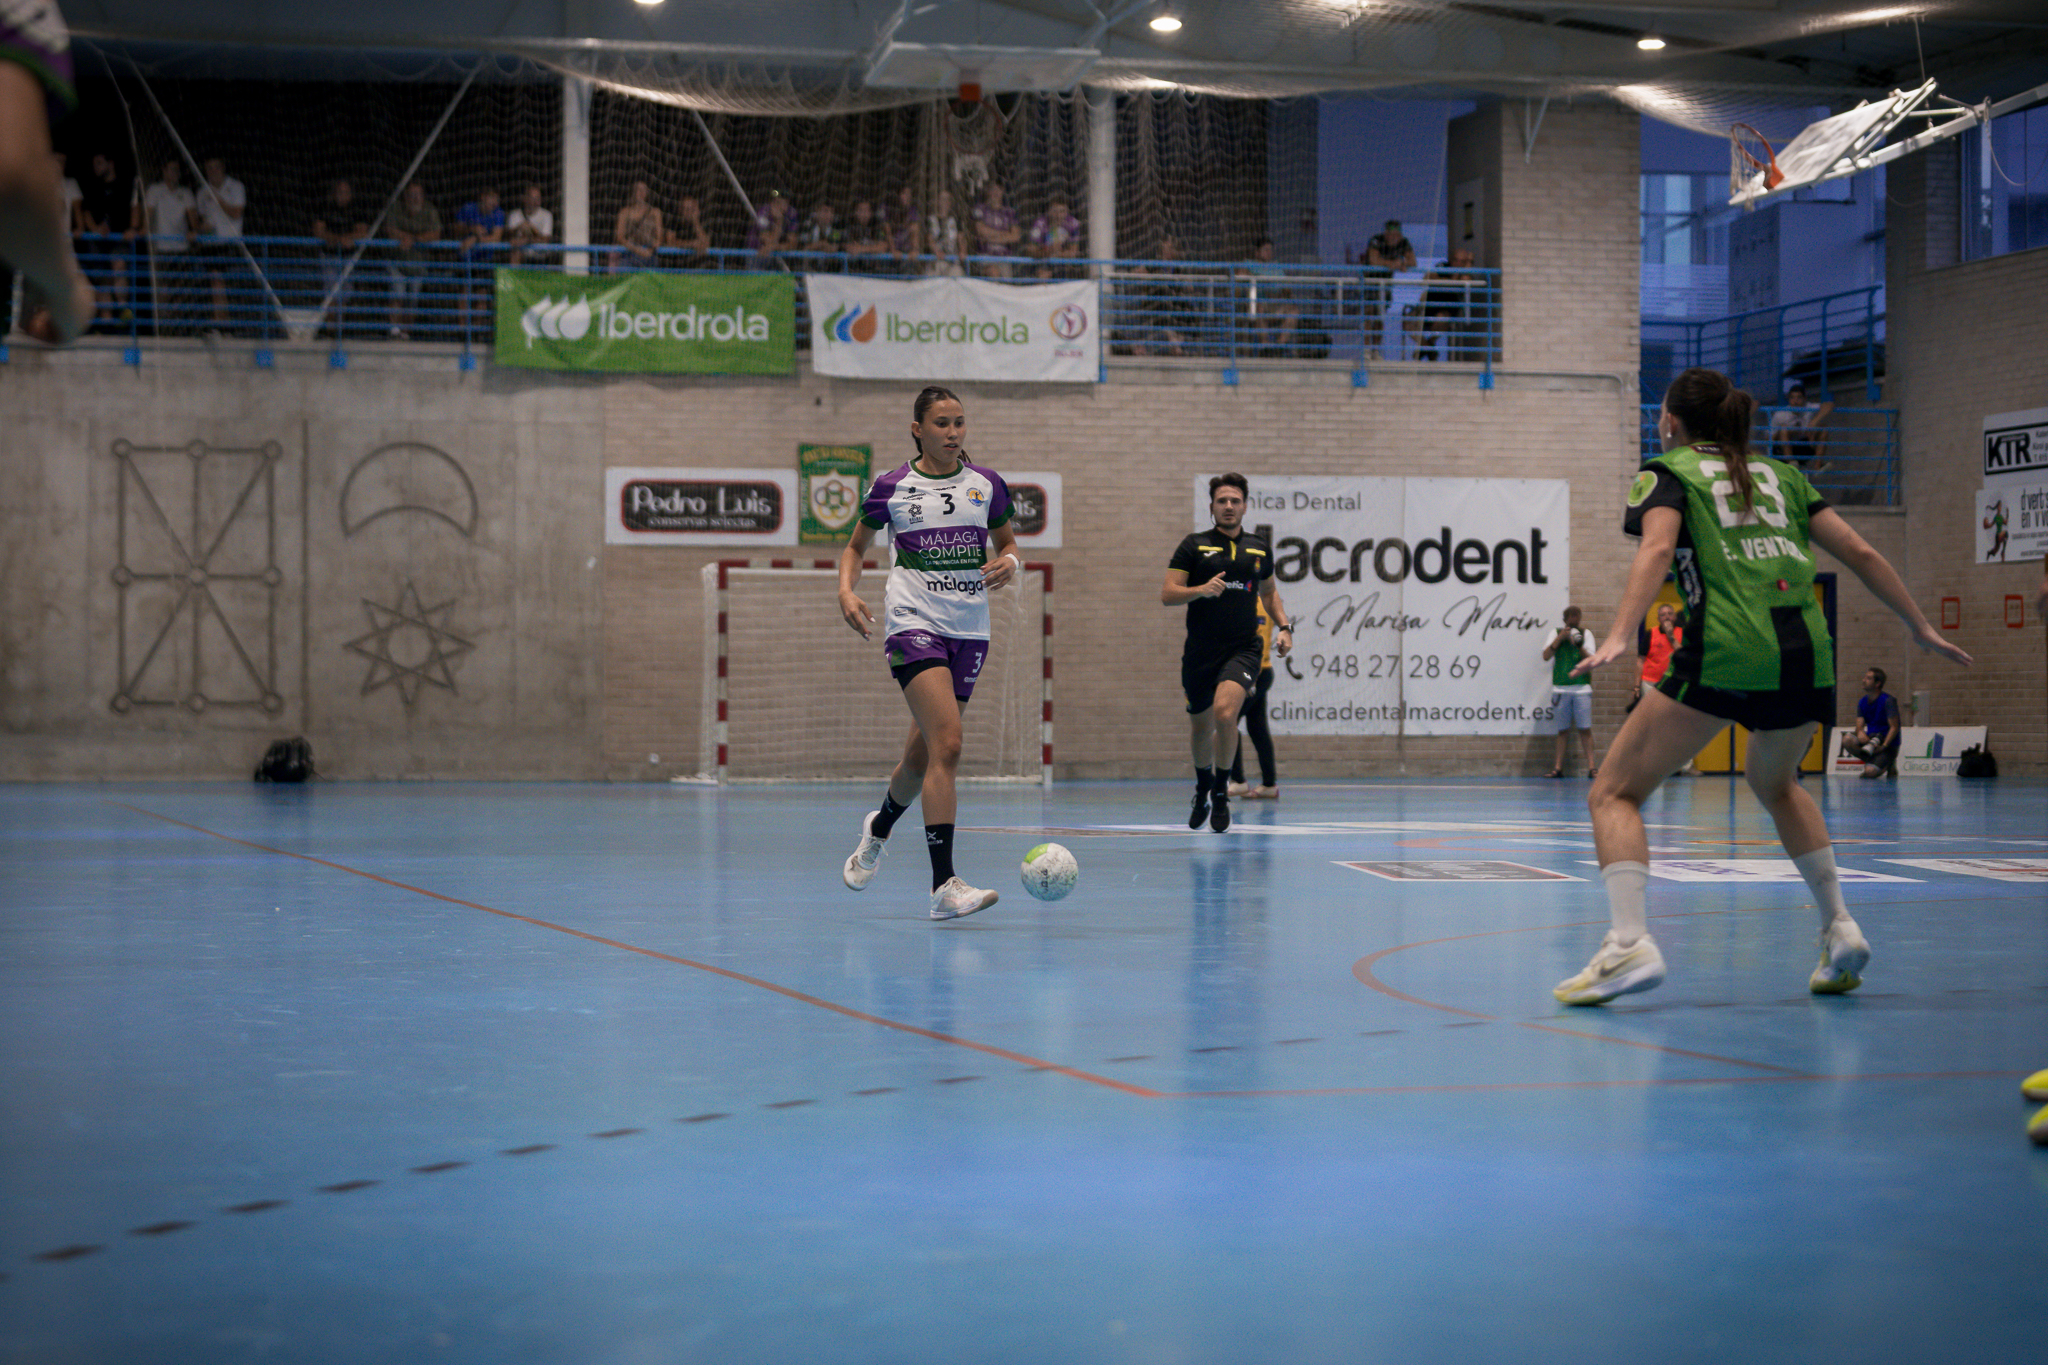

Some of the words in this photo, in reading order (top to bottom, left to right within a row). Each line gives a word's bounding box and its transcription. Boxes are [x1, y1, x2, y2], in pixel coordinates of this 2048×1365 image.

[598, 302, 770, 344] Iberdrola
[886, 312, 1030, 346] Iberdrola
[1988, 433, 2031, 467] KTR
[632, 486, 707, 514] Pedro
[717, 486, 772, 515] Luis
[941, 493, 956, 515] 3
[1294, 491, 1362, 511] Dental
[1699, 461, 1788, 528] 23
[919, 544, 983, 560] COMPITE
[920, 531, 979, 547] MÁLAGA
[1315, 591, 1430, 640] Marisa
[972, 652, 983, 674] 3
[1311, 654, 1360, 679] 948
[1368, 654, 1400, 679] 27
[1410, 655, 1441, 679] 28
[1450, 655, 1482, 679] 69
